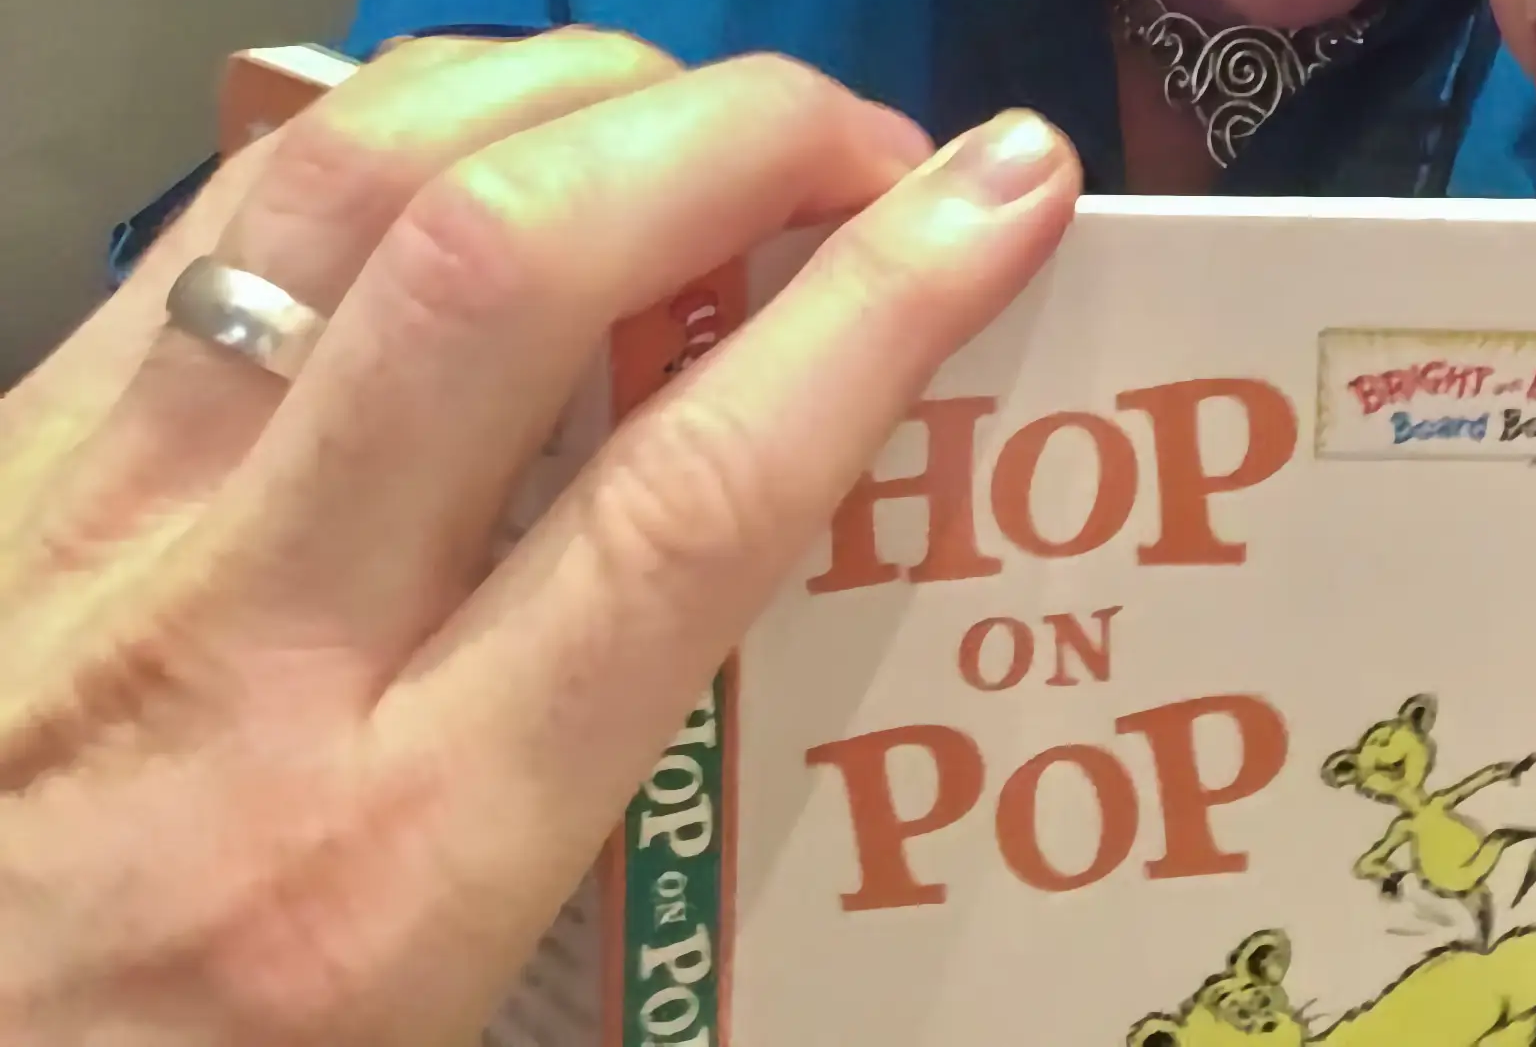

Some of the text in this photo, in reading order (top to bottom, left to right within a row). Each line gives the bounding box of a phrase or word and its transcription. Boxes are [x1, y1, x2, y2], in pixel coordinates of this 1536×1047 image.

[1348, 358, 1495, 415] BRIGHT
[804, 378, 1298, 595] HOP
[957, 605, 1123, 692] ON
[804, 693, 1290, 912] POP
[654, 870, 689, 928] ON
[639, 922, 711, 1047] PO
